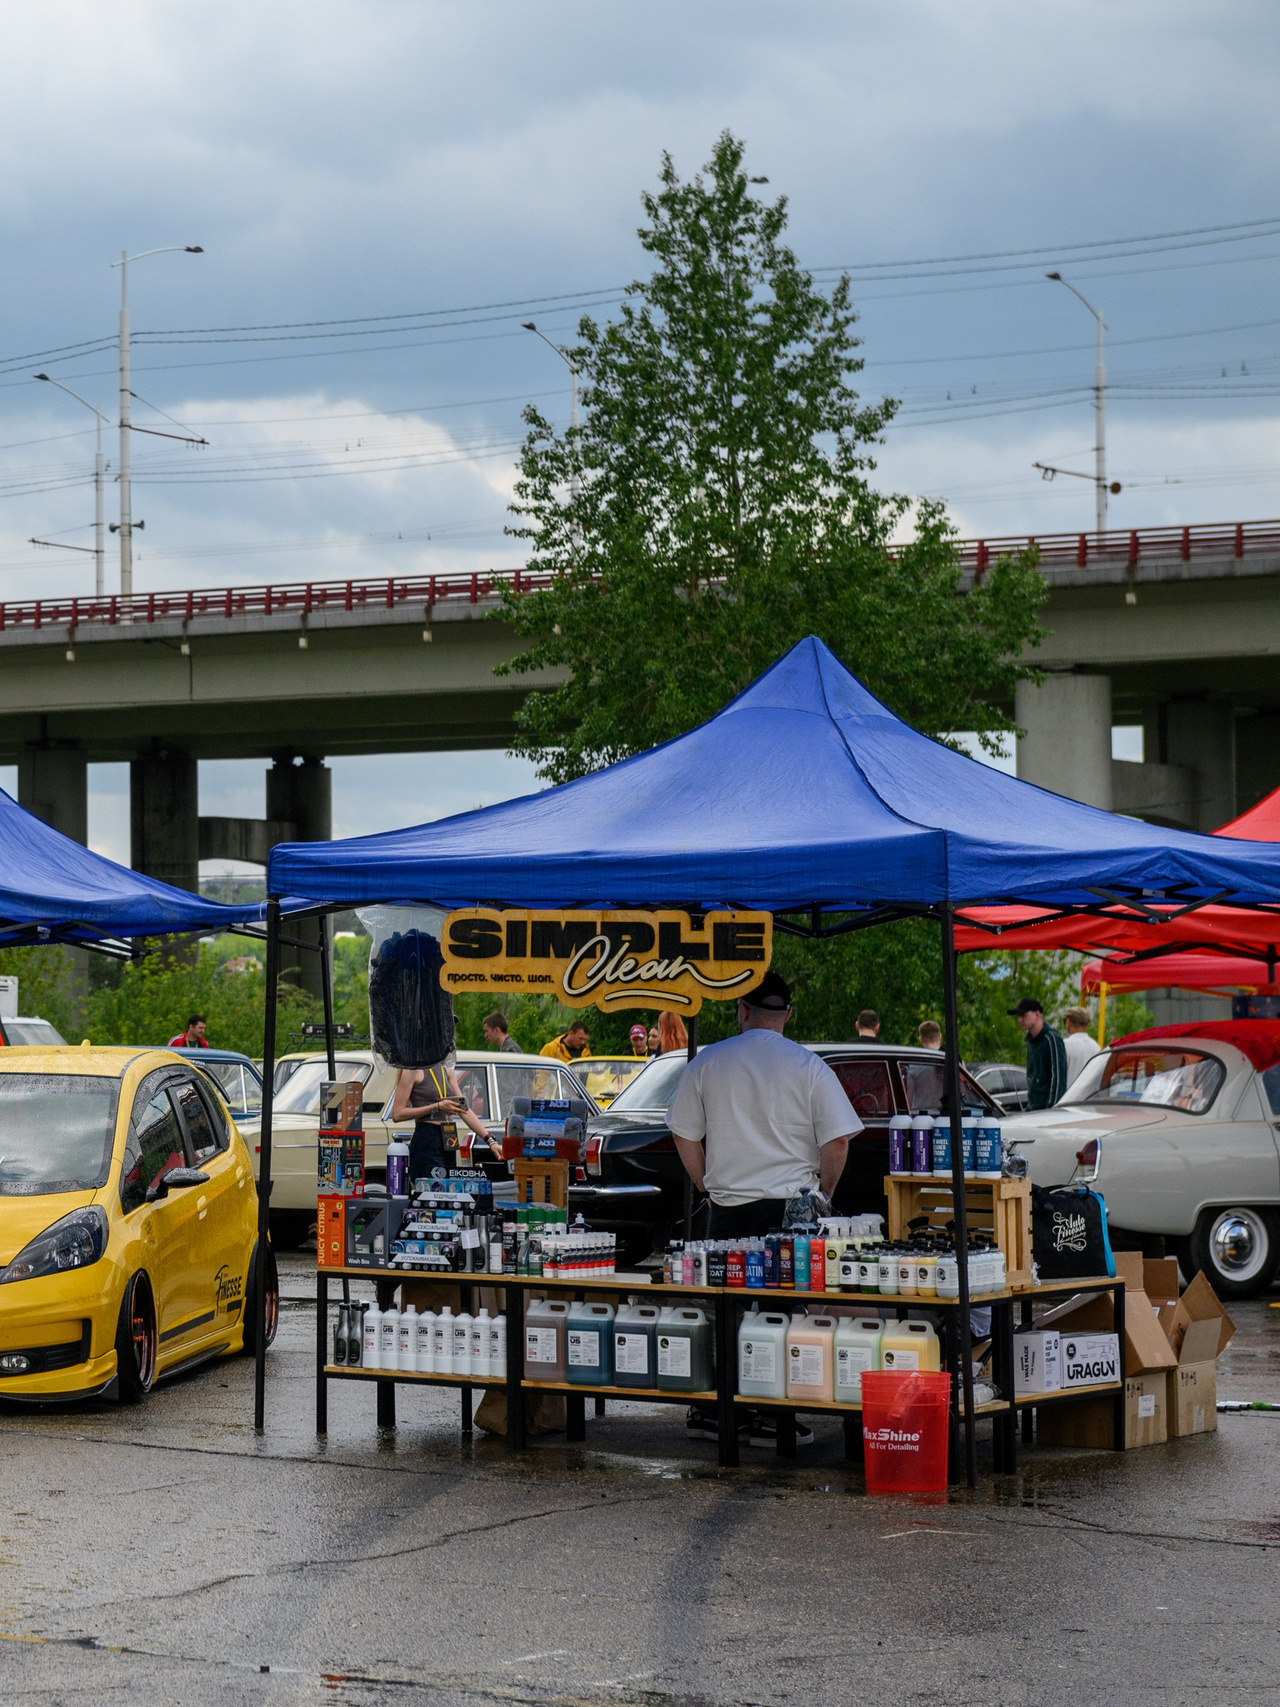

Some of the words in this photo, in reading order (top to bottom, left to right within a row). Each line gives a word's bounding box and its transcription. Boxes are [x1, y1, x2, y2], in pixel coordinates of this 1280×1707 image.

[447, 918, 765, 961] SIMPLE
[562, 935, 754, 996] Clean
[447, 972, 488, 983] просто.
[490, 973, 524, 983] чисто.
[527, 974, 554, 983] шоп.
[449, 1169, 487, 1178] EIKOSHA
[348, 1257, 360, 1265] Wash
[1067, 1360, 1115, 1380] URAGUN
[876, 1442, 886, 1450] For
[888, 1443, 919, 1451] Detailing
